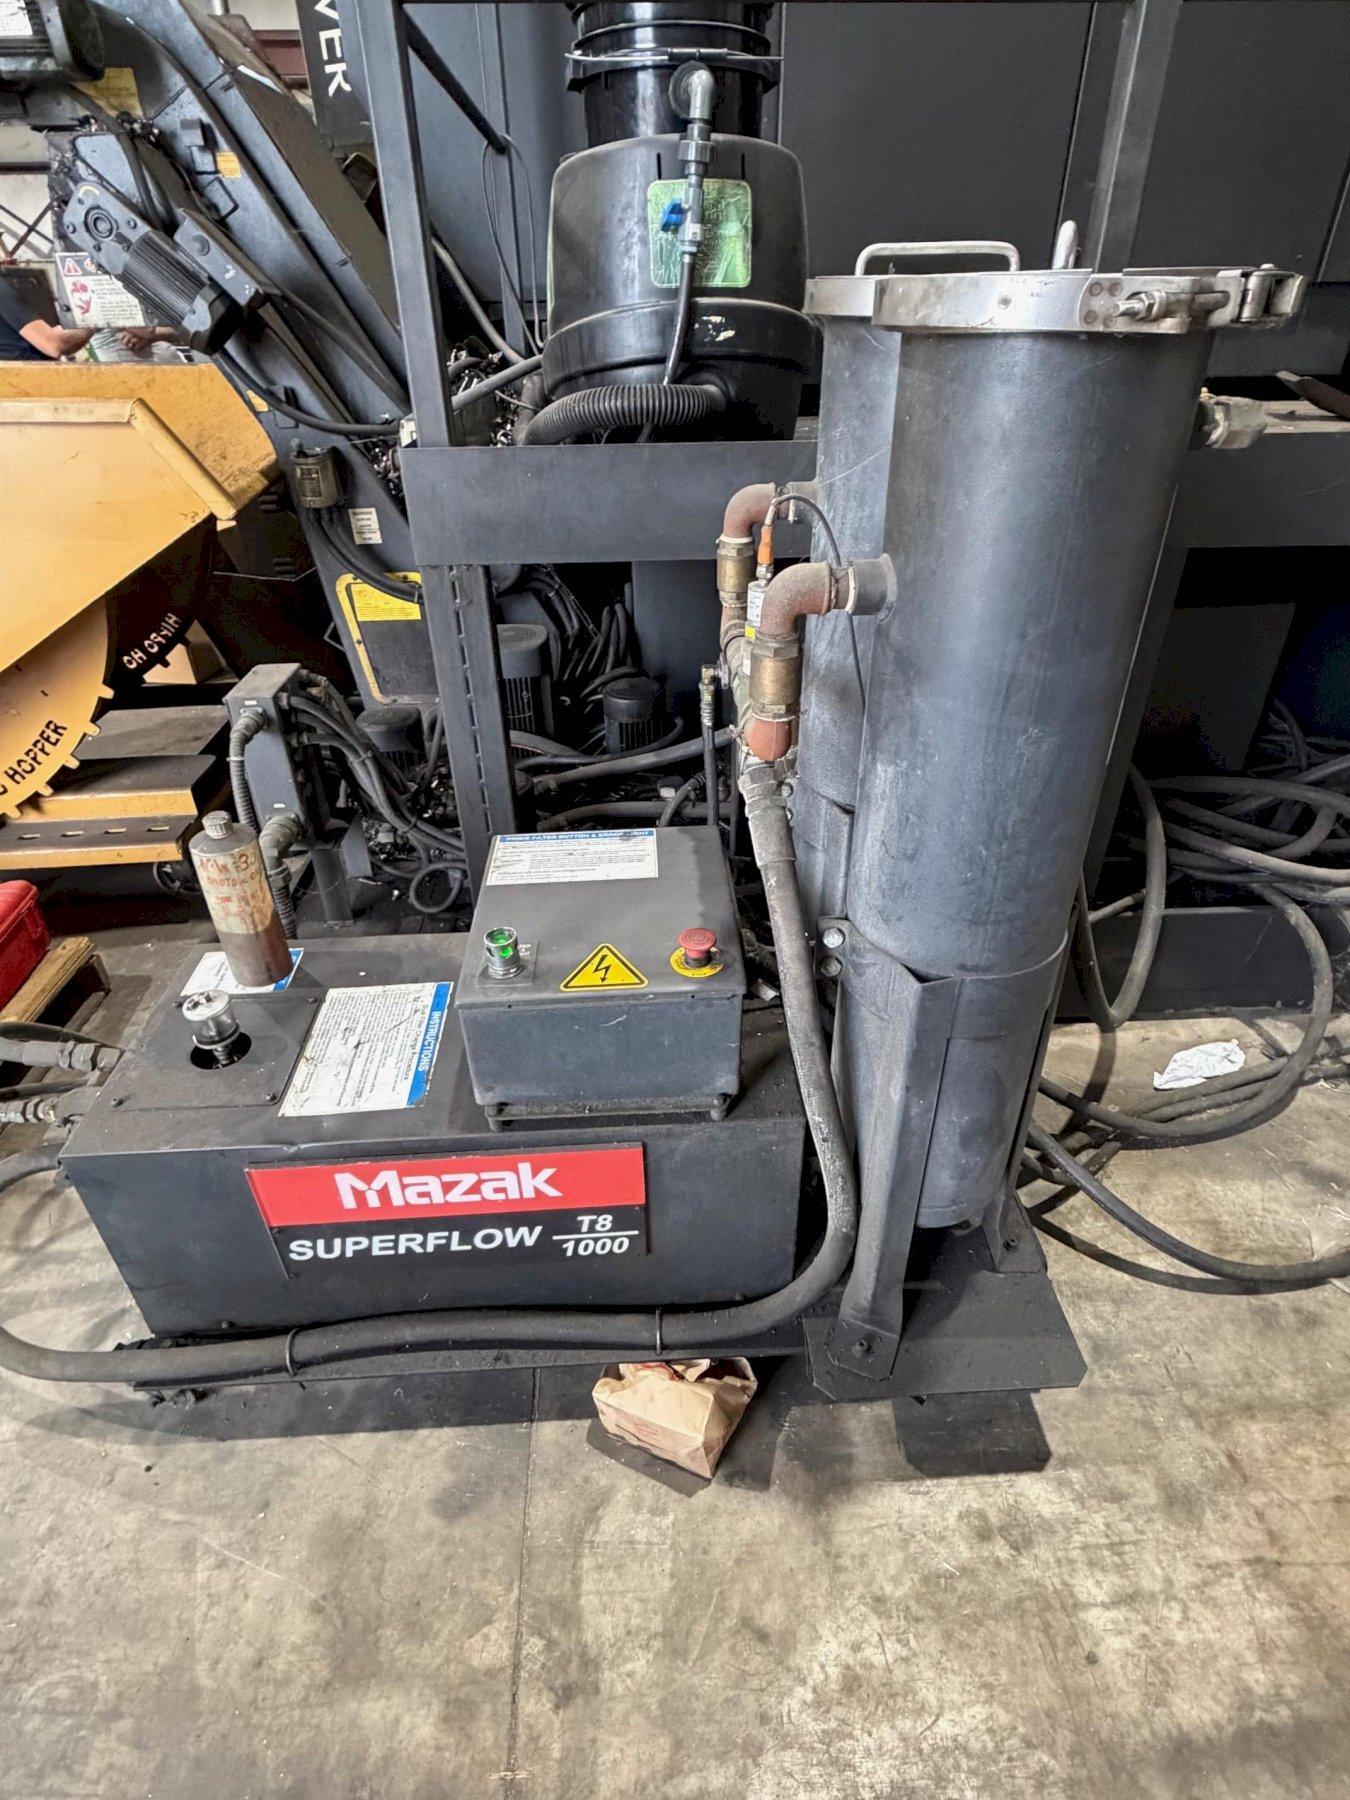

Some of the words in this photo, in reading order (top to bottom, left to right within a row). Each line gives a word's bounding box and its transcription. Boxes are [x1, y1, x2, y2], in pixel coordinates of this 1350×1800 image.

[4, 720, 67, 784] HOPPER
[418, 1011, 442, 1072] INSTRUCTIONS
[334, 1162, 563, 1209] Mazak
[288, 1226, 543, 1261] SUPERFLOW
[577, 1215, 613, 1233] T8
[561, 1237, 630, 1257] 1000
